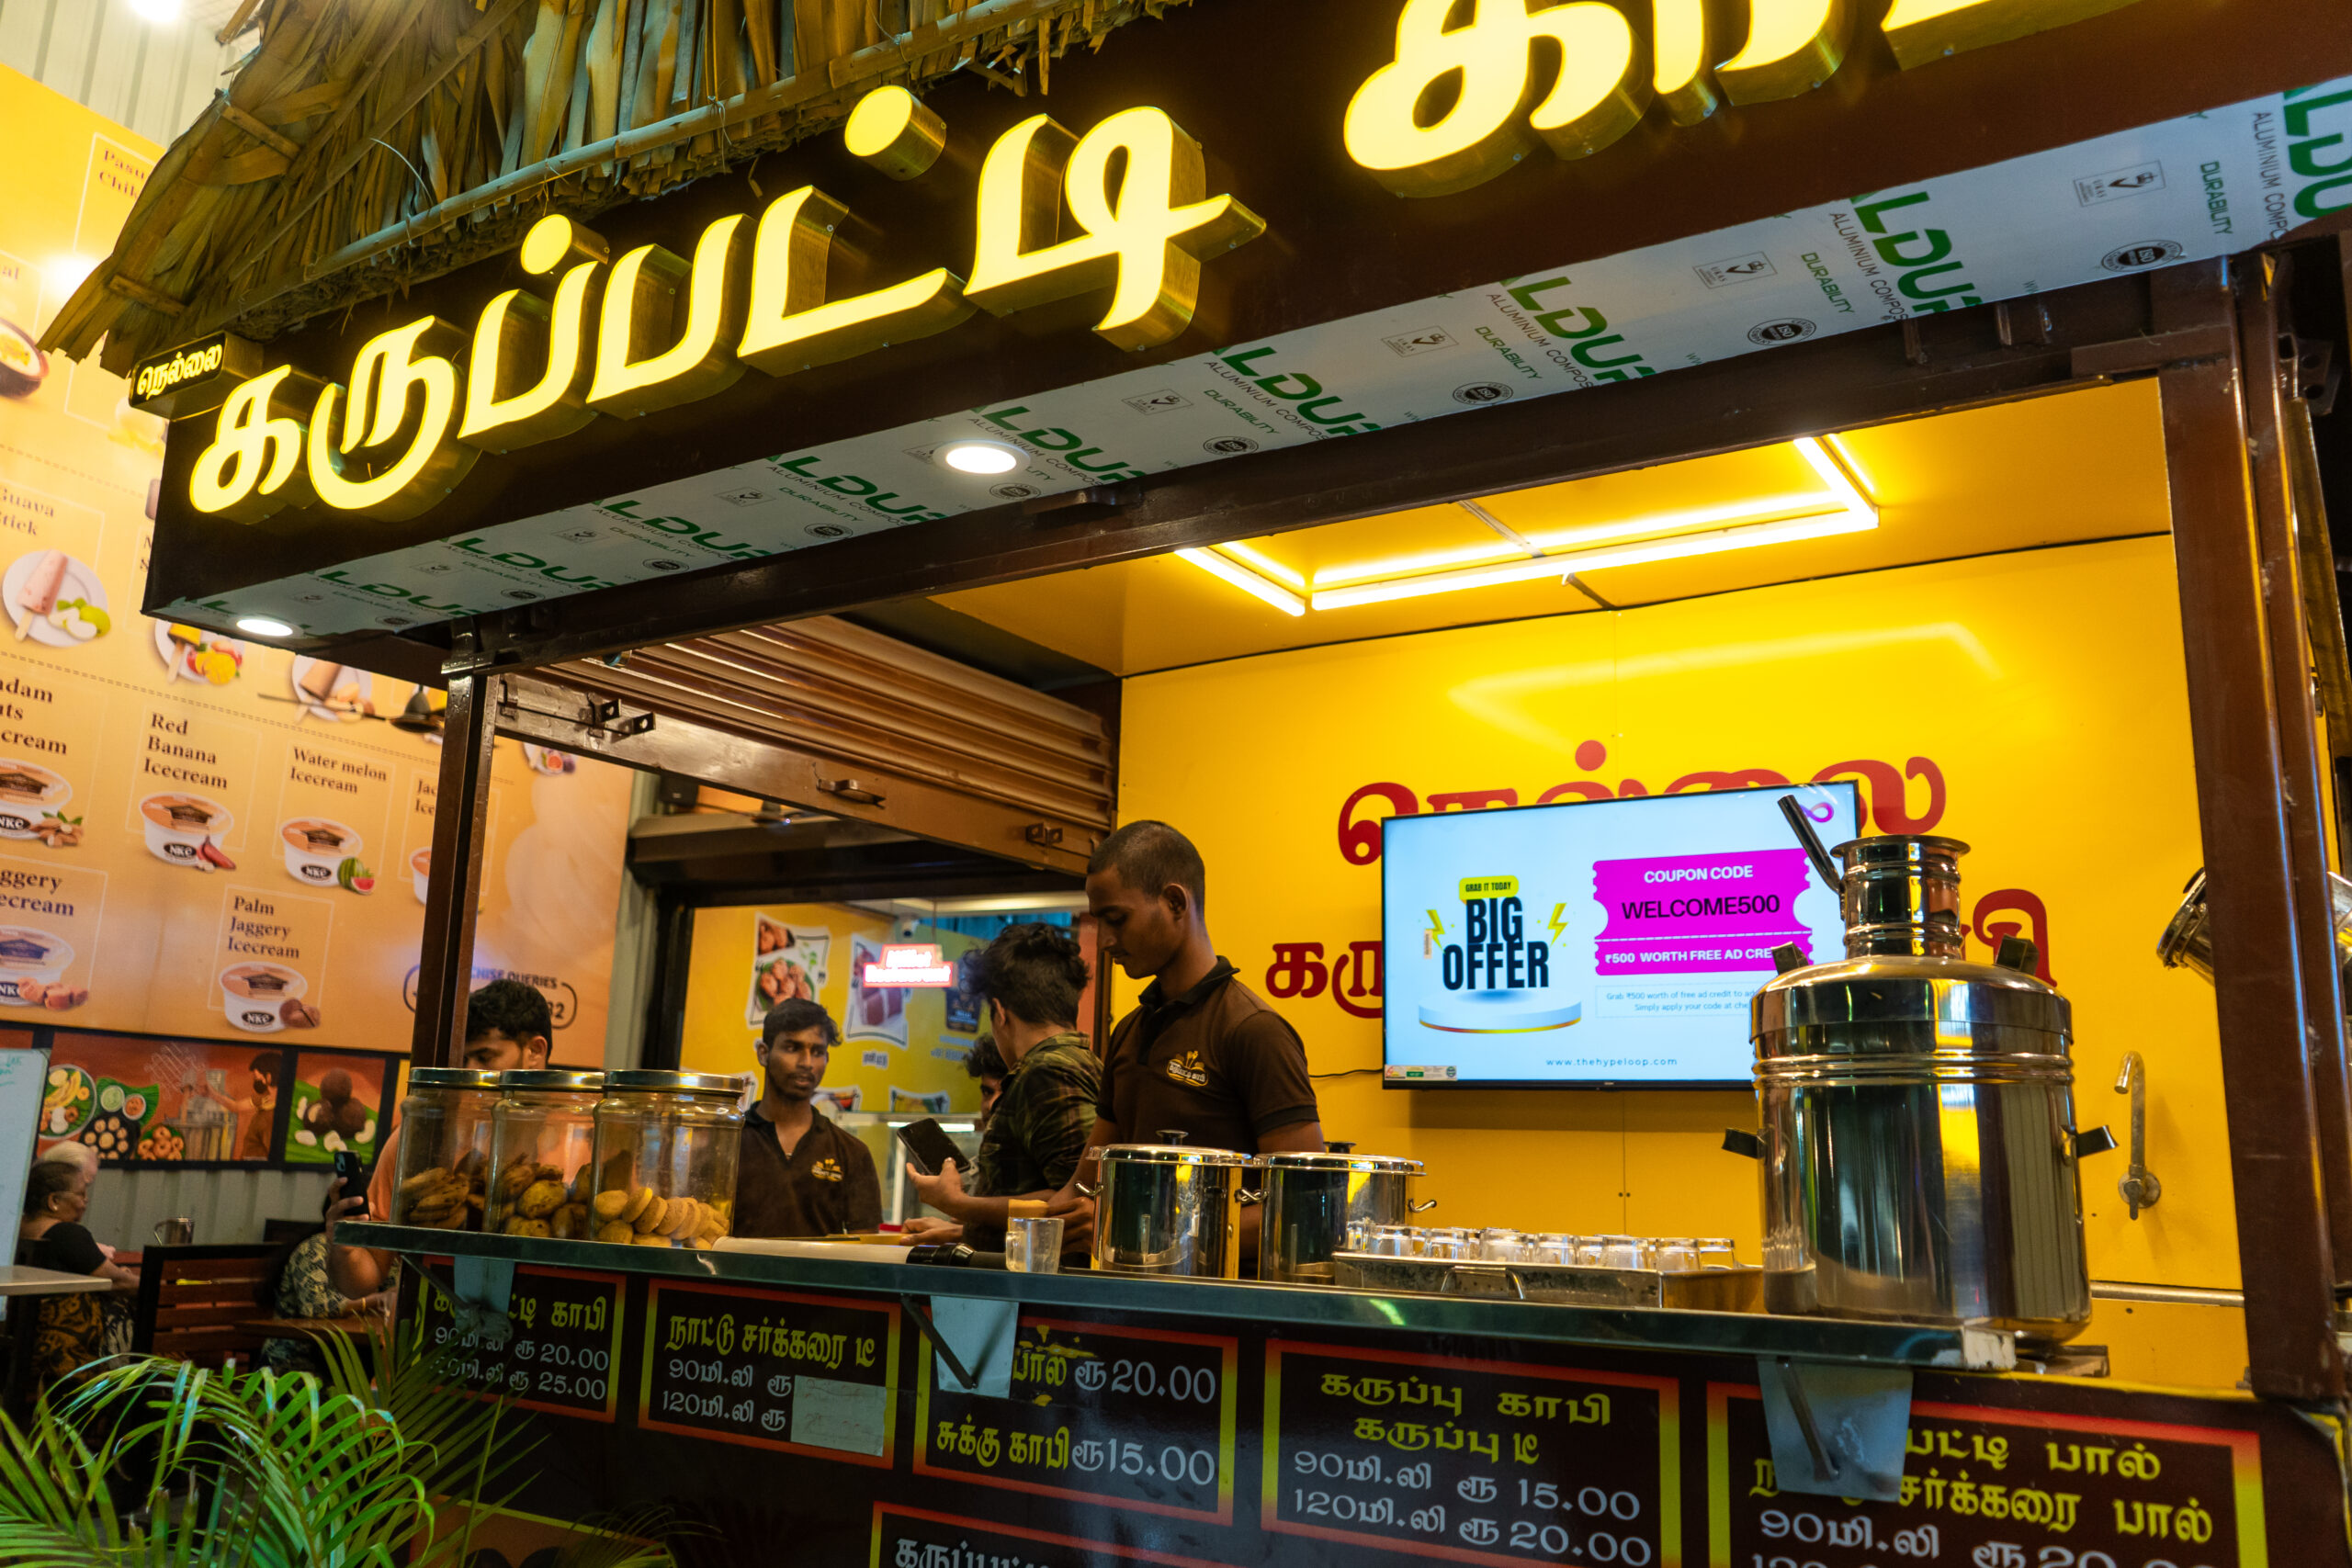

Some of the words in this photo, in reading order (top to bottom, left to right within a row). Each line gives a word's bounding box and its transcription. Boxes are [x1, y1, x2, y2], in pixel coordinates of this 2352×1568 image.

[2253, 111, 2281, 189] ALUMINIUM
[2199, 161, 2233, 234] DURABILITY
[1829, 212, 1880, 276] ALUMINIUM
[2137, 248, 2156, 263] ISO
[188, 85, 1233, 514] கருப்பட்டி
[1801, 252, 1855, 313] DURABILITY
[1486, 293, 1551, 347] ALUMINIUM
[1777, 325, 1796, 338] ISO
[1475, 326, 1543, 379] DURABILITY
[137, 344, 222, 400] நெல்லை
[1204, 361, 1278, 407] ALUMINIUM
[1204, 389, 1281, 434] DURABILITY
[1476, 388, 1497, 400] ISO
[967, 417, 1045, 457] ALUMINIUM
[765, 466, 848, 502] ALUMINIUM
[778, 487, 865, 522] DURABILITY
[151, 712, 188, 736] Red
[147, 735, 217, 765] Banana
[293, 745, 338, 770] Water
[341, 761, 388, 782] melon
[143, 757, 228, 790] Icecream
[289, 765, 358, 795] Icecream
[1465, 884, 1482, 892] GRAB
[1484, 883, 1489, 891] IT
[1491, 882, 1511, 891] TODAY
[1644, 868, 1707, 884] COUPON
[1710, 865, 1754, 880] CODE
[234, 896, 275, 916] Palm
[1466, 896, 1523, 943] BIG
[1622, 894, 1780, 919] WELCOME500
[228, 935, 300, 959] Icecream
[230, 916, 291, 942] Jaggery
[1442, 941, 1549, 990] OFFER
[1605, 953, 1635, 964] ₹500
[1640, 951, 1688, 963] WORTH
[1690, 950, 1723, 961] FREE
[1724, 949, 1743, 960] AD
[1634, 1003, 1659, 1011] Simply
[1545, 1057, 1678, 1067] www.thehypeloop.com
[551, 1295, 607, 1332] காபி
[539, 1343, 609, 1371] 20.00
[664, 1314, 735, 1356] நாட்டு
[741, 1316, 848, 1370] சர்க்கரை
[855, 1337, 876, 1367] டீ
[537, 1371, 606, 1400] 25.00
[669, 1359, 753, 1388] 90மி.லி
[662, 1391, 754, 1423] 120மி.லி
[1320, 1372, 1463, 1417] கருப்பு
[1497, 1391, 1611, 1426] காபி
[936, 1414, 1001, 1468] சுக்கு
[1009, 1426, 1070, 1470] காபி
[1353, 1416, 1499, 1463] கருப்பு
[1513, 1431, 1541, 1464] டீ
[2045, 1442, 2161, 1481] பால்
[1294, 1450, 1432, 1491] 90மி.லி
[1519, 1478, 1640, 1521] 15.00
[1295, 1487, 1446, 1534] 120மி.லி
[1510, 1521, 1651, 1566] 20.00
[1759, 1508, 1939, 1560] 90மி.லி
[2111, 1496, 2213, 1544] பால்
